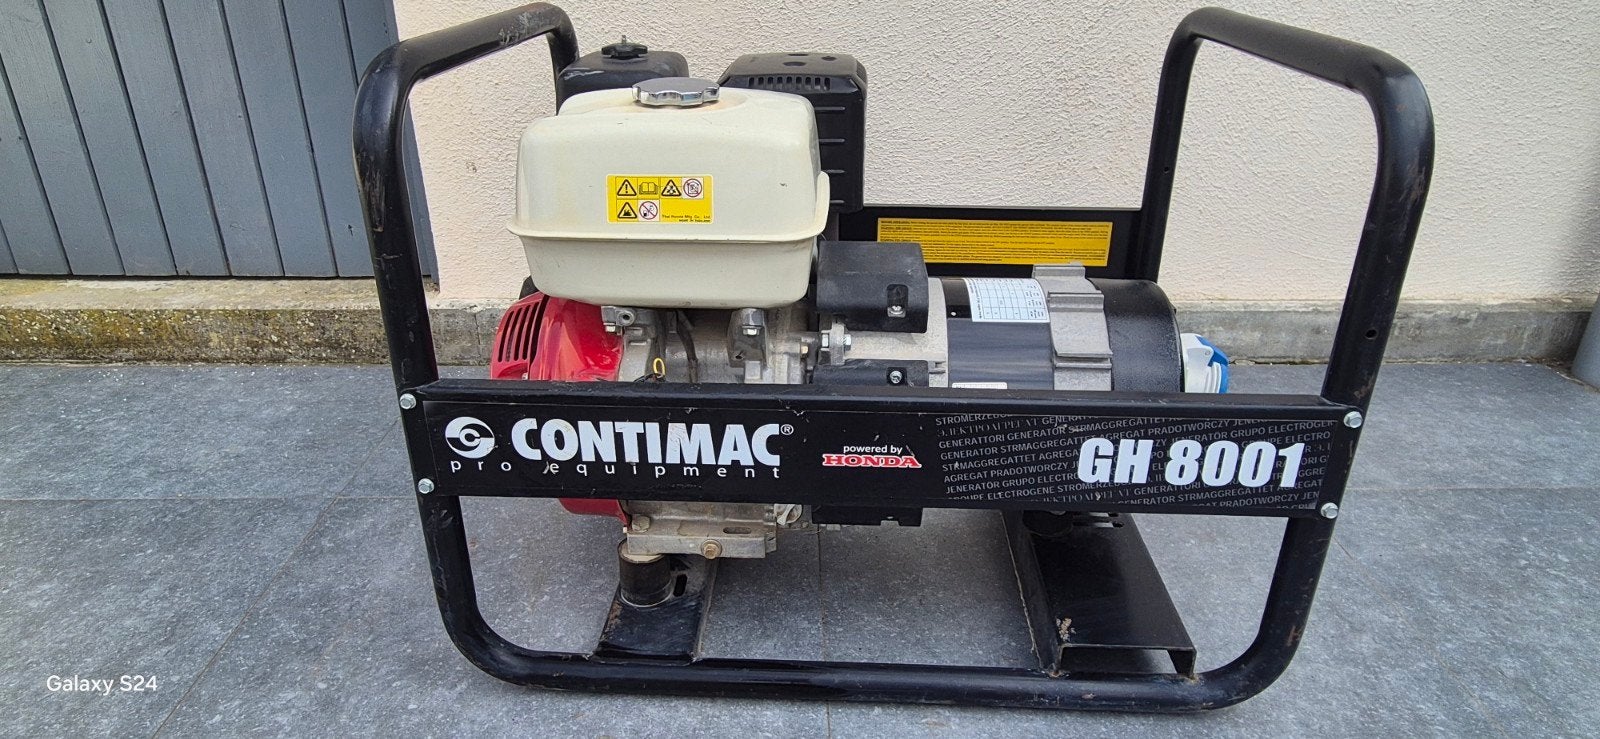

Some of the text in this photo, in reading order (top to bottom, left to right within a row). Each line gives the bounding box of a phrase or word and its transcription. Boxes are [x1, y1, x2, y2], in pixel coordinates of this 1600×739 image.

[939, 434, 1005, 449] GENERATTORI
[1007, 424, 1067, 441] GENERATOR
[843, 444, 903, 455] powered by
[940, 446, 998, 460] GENERATOR
[942, 453, 1037, 472] STRMAGGREGATTET
[1230, 426, 1267, 438] GRUPO
[451, 459, 780, 479] pro equipment
[822, 453, 922, 468] HONDA
[1077, 437, 1306, 488] GH 8001
[943, 470, 988, 483] AGREGAT
[990, 461, 1069, 478] PRADOTWORCZY
[945, 480, 1000, 494] JENERATOR
[1002, 477, 1035, 488] GRUPO
[987, 485, 1055, 501] ELECTROGENE
